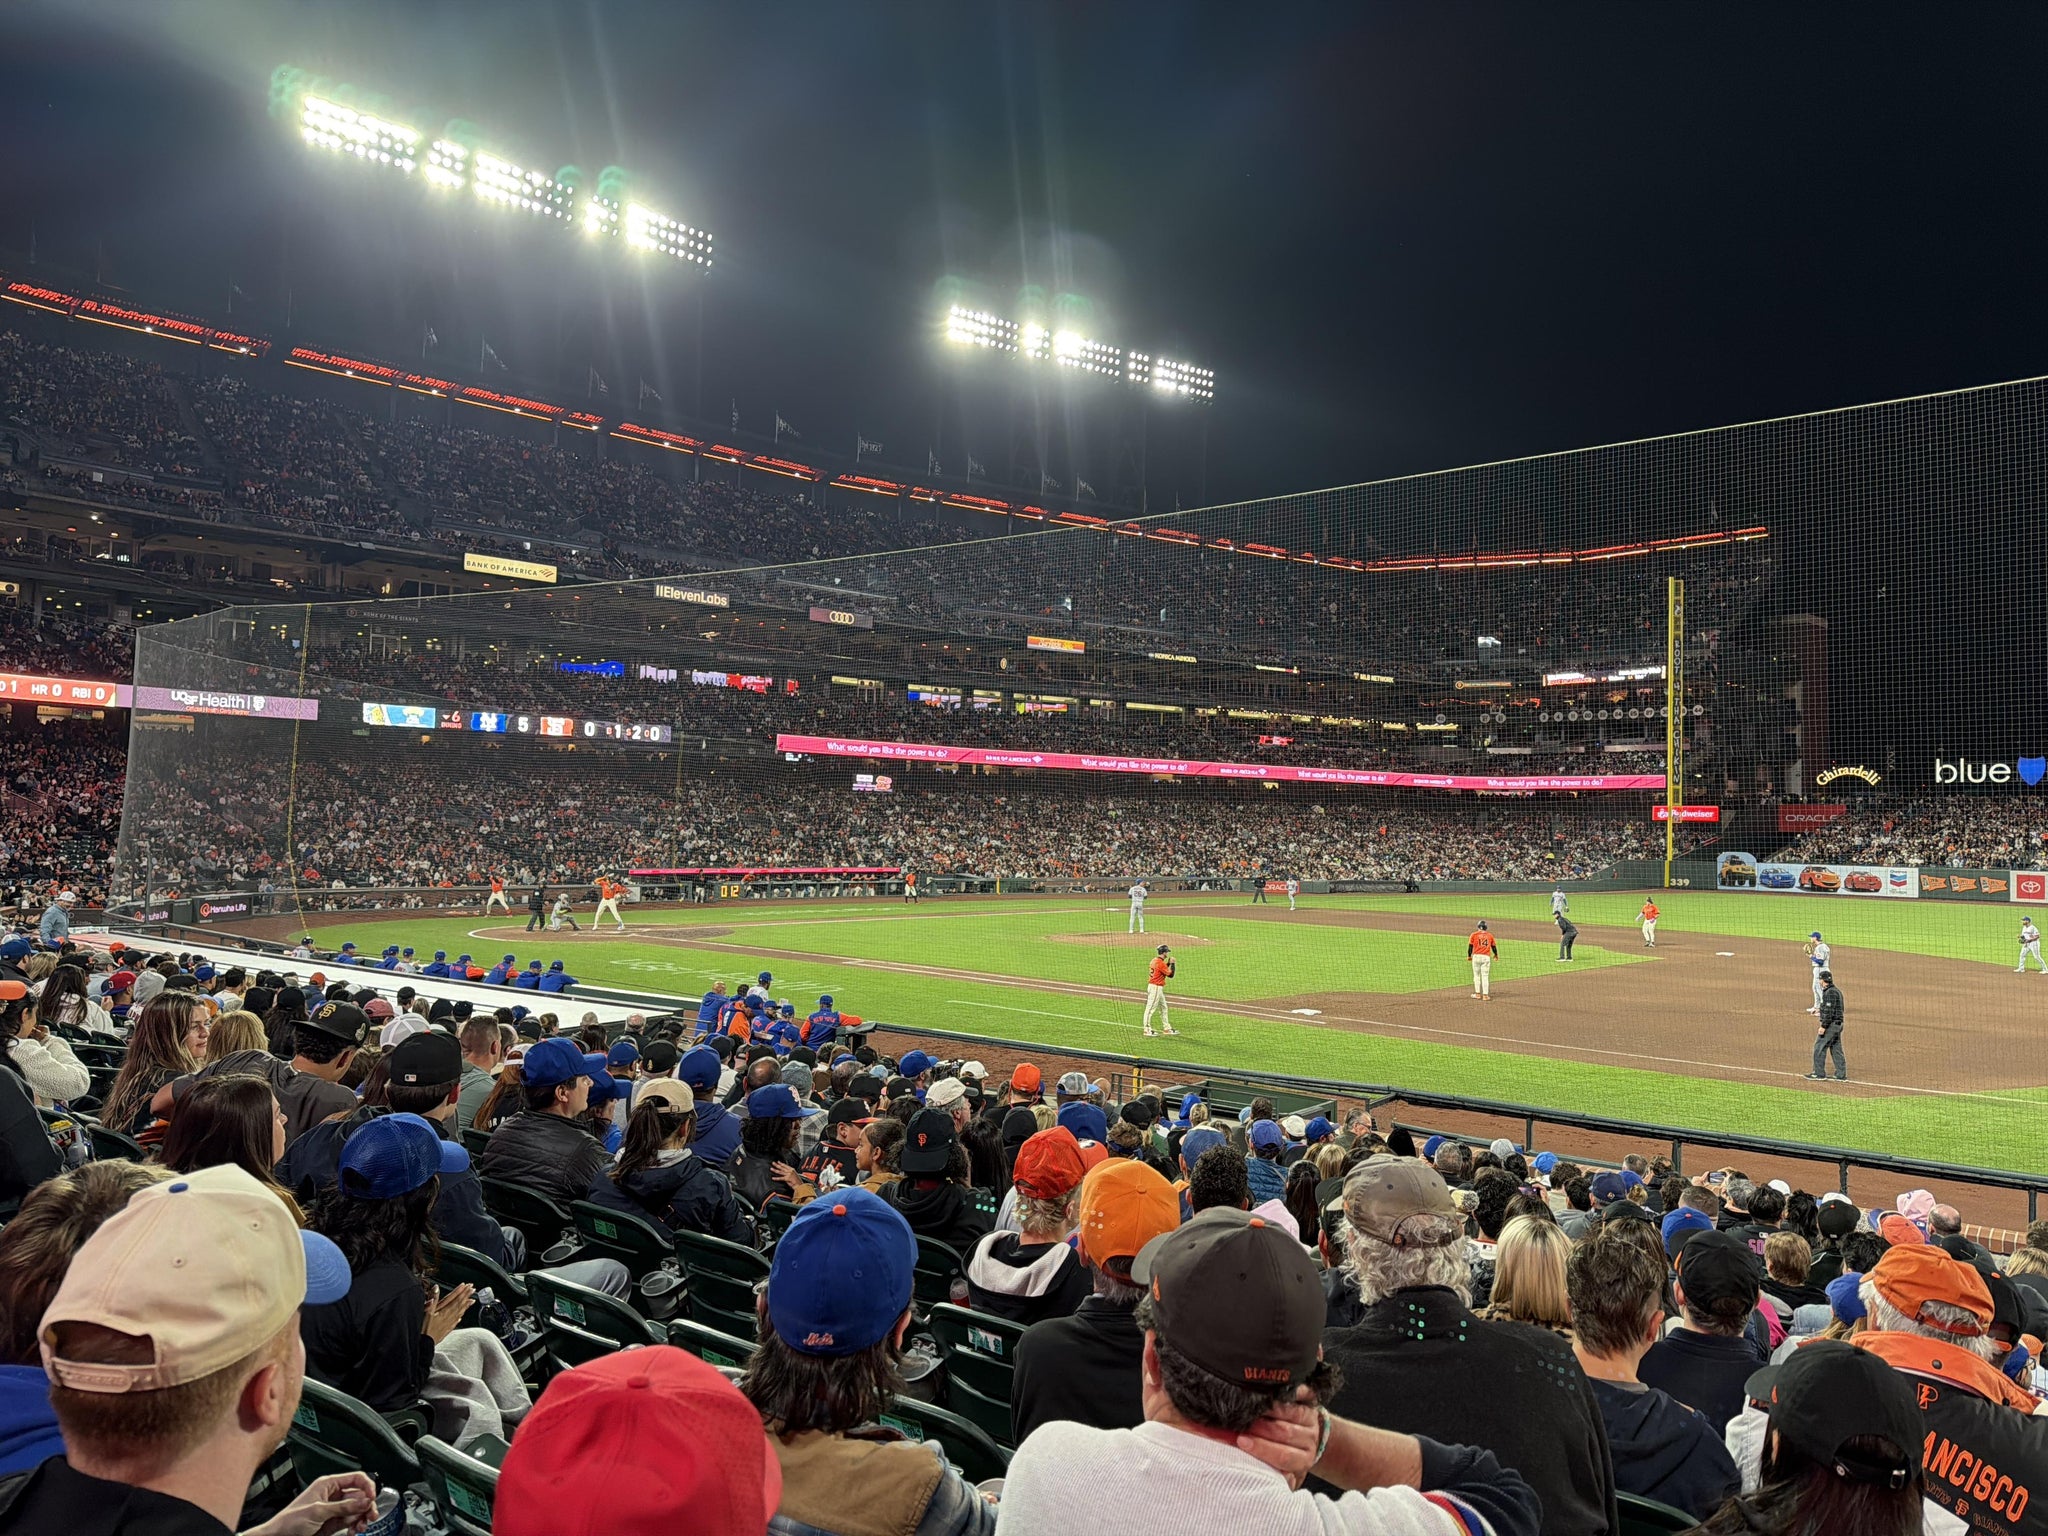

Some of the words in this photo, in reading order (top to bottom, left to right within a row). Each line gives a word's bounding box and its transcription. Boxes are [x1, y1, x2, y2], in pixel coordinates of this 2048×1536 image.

[466, 560, 489, 569] BANK
[502, 565, 538, 576] AMERICA
[11, 680, 17, 693] 1
[31, 684, 48, 696] HR
[52, 684, 62, 697] 0
[72, 687, 91, 699] RBI
[95, 687, 105, 700] 0
[199, 693, 245, 710] Health
[451, 711, 461, 722] 6
[518, 716, 529, 732] 5
[584, 721, 595, 737] 0
[614, 724, 622, 738] 1
[632, 725, 641, 740] 2
[650, 726, 660, 741] 0
[827, 742, 845, 750] What
[936, 749, 948, 757] do?
[1081, 758, 1098, 766] What
[1816, 765, 1882, 786] Ghirardelli
[1935, 757, 2012, 784] blue
[1487, 779, 1505, 787] What
[1526, 780, 1537, 788] you
[1538, 778, 1550, 786] like
[1562, 779, 1581, 788] power
[1670, 878, 1690, 887] 339
[211, 903, 235, 913] Hanwha
[235, 903, 247, 912] Life
[1478, 938, 1488, 947] 14
[917, 1133, 928, 1147] SF
[803, 1332, 834, 1346] Mets
[1244, 1366, 1290, 1382] GIANTS
